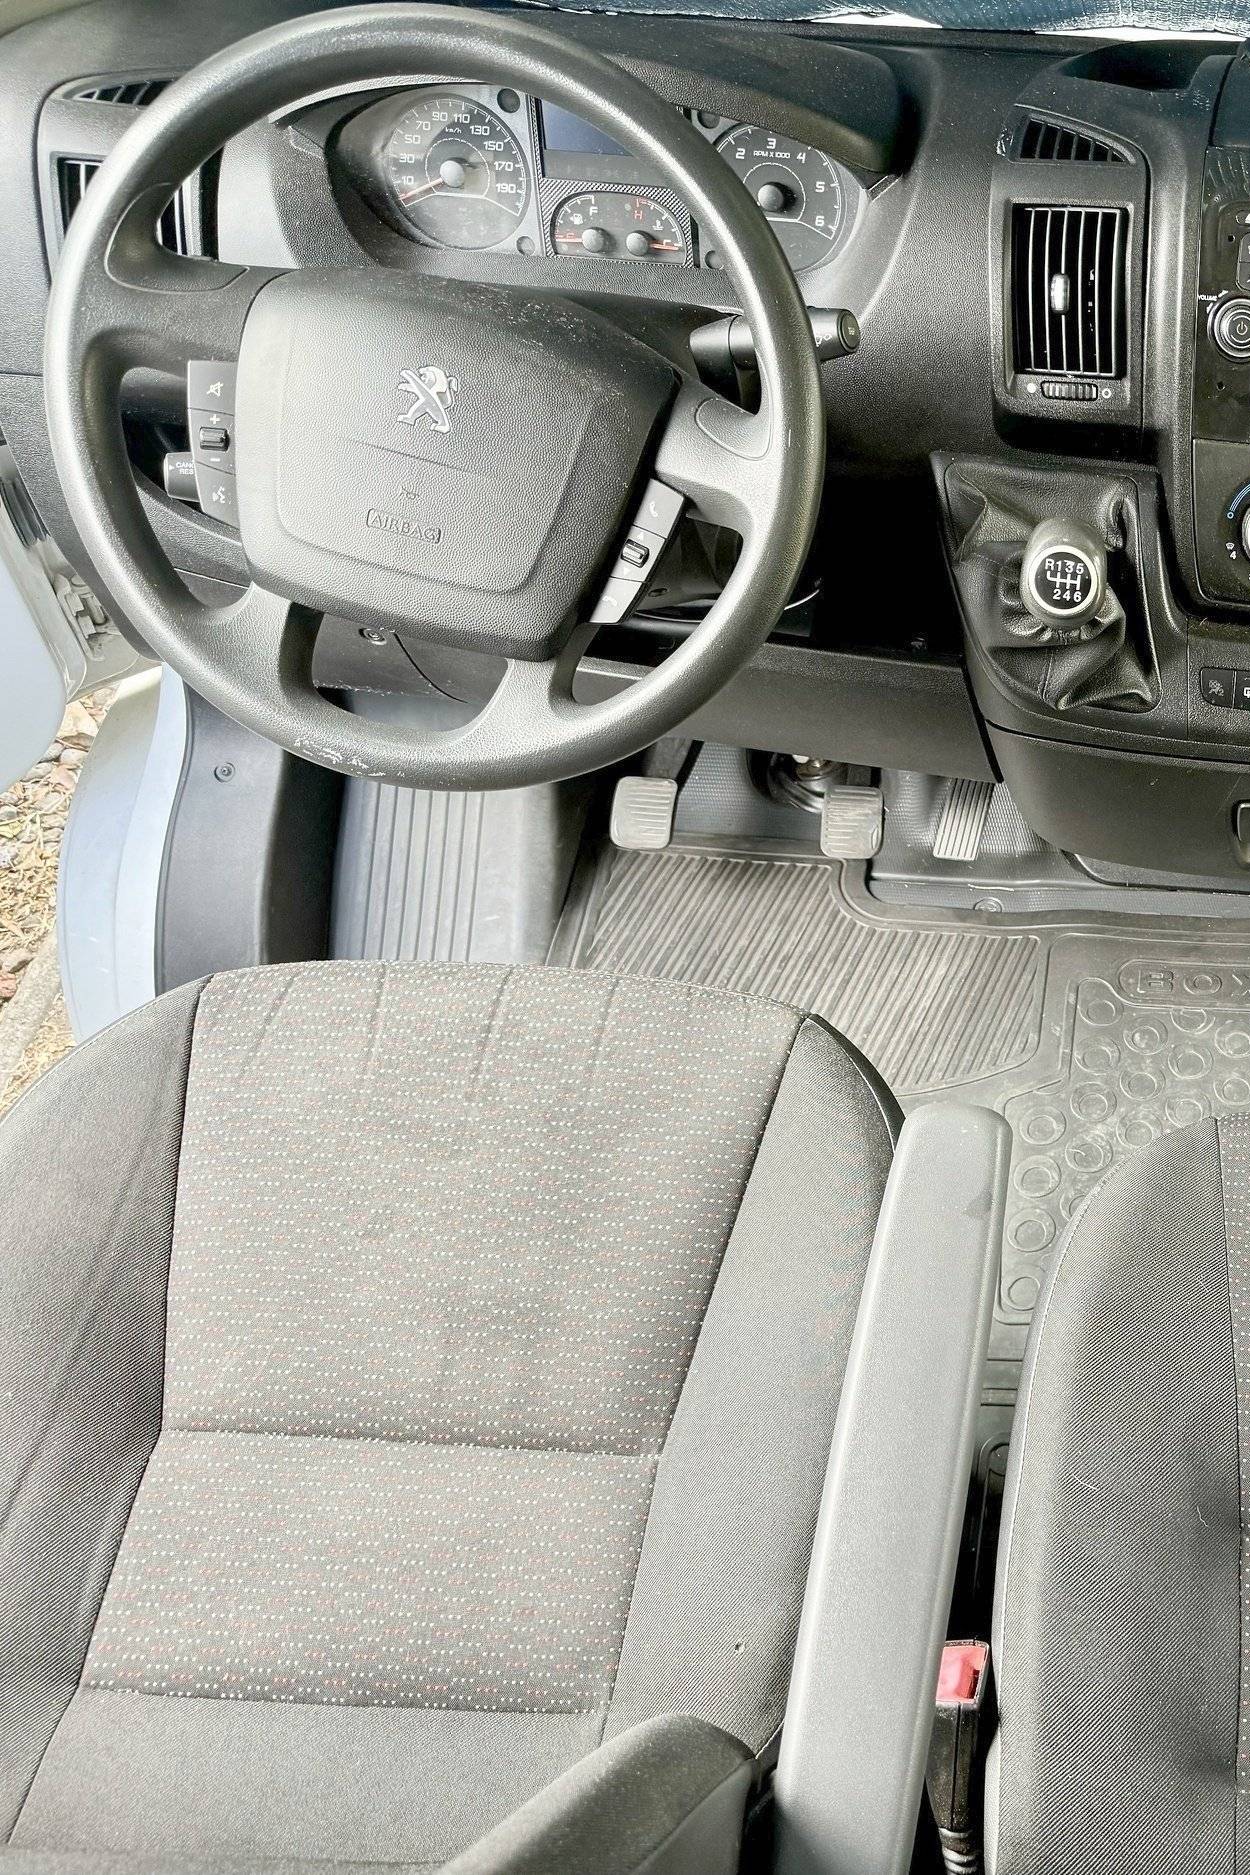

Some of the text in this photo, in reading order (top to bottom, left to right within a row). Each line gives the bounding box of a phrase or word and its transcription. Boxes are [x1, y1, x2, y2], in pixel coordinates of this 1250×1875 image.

[432, 112, 448, 121] 90
[453, 113, 470, 124] 110
[416, 121, 431, 131] 70
[469, 125, 490, 135] 130
[404, 135, 421, 144] 50
[766, 138, 776, 149] 3
[483, 141, 504, 151] 150
[399, 153, 415, 163] 30
[735, 148, 745, 159] 2
[796, 152, 806, 163] 4
[493, 161, 513, 171] 170
[401, 175, 414, 185] 10
[495, 183, 516, 194] 190
[815, 181, 825, 192] 5
[589, 206, 598, 216] F
[634, 210, 643, 219] H
[815, 215, 825, 226] 6
[371, 514, 436, 541] AIRBAG
[1229, 550, 1237, 560] 4
[1044, 558, 1084, 574] R 1 3 5
[1052, 588, 1082, 602] 2 4 6
